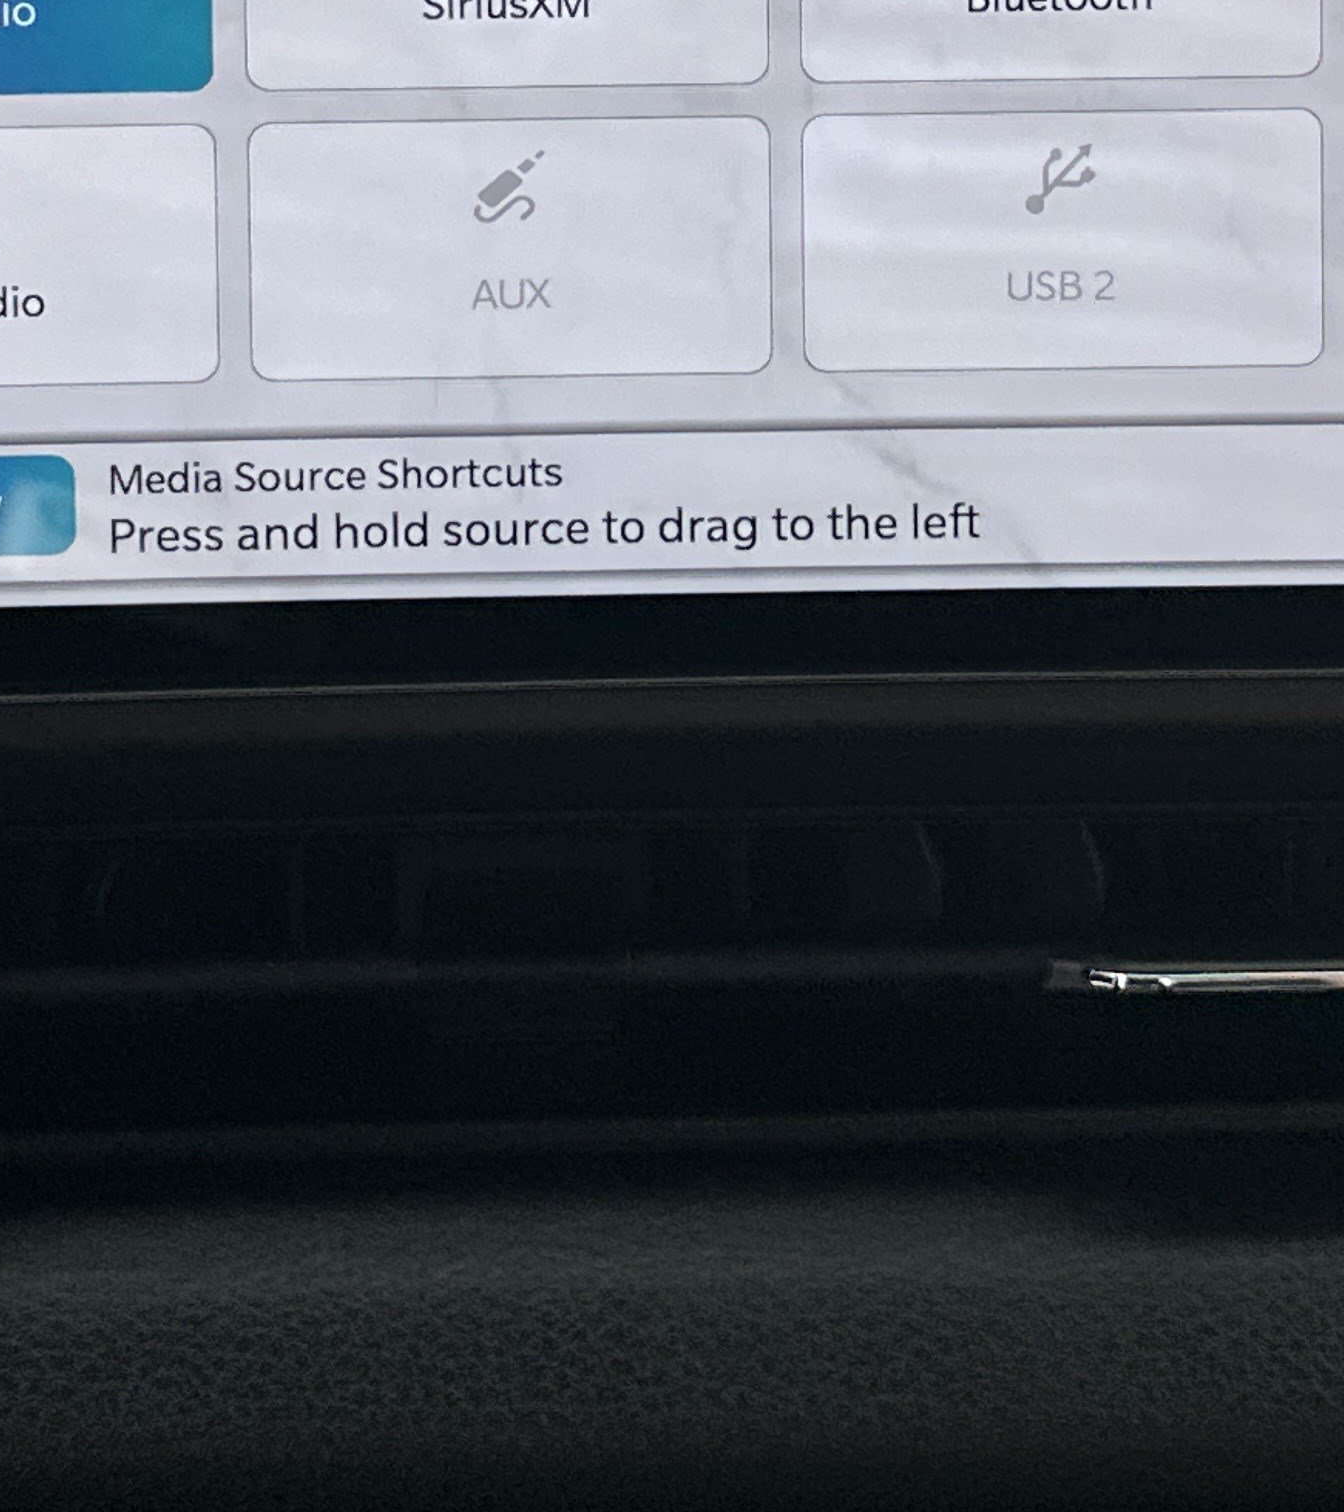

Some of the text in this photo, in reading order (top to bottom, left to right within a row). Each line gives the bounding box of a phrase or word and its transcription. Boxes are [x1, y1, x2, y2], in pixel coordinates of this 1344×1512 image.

[471, 278, 552, 311] AUX
[1006, 270, 1116, 302] USB 2
[108, 456, 564, 495] Media Source Shortcuts
[109, 502, 981, 554] Press and hold source to drag to the left
